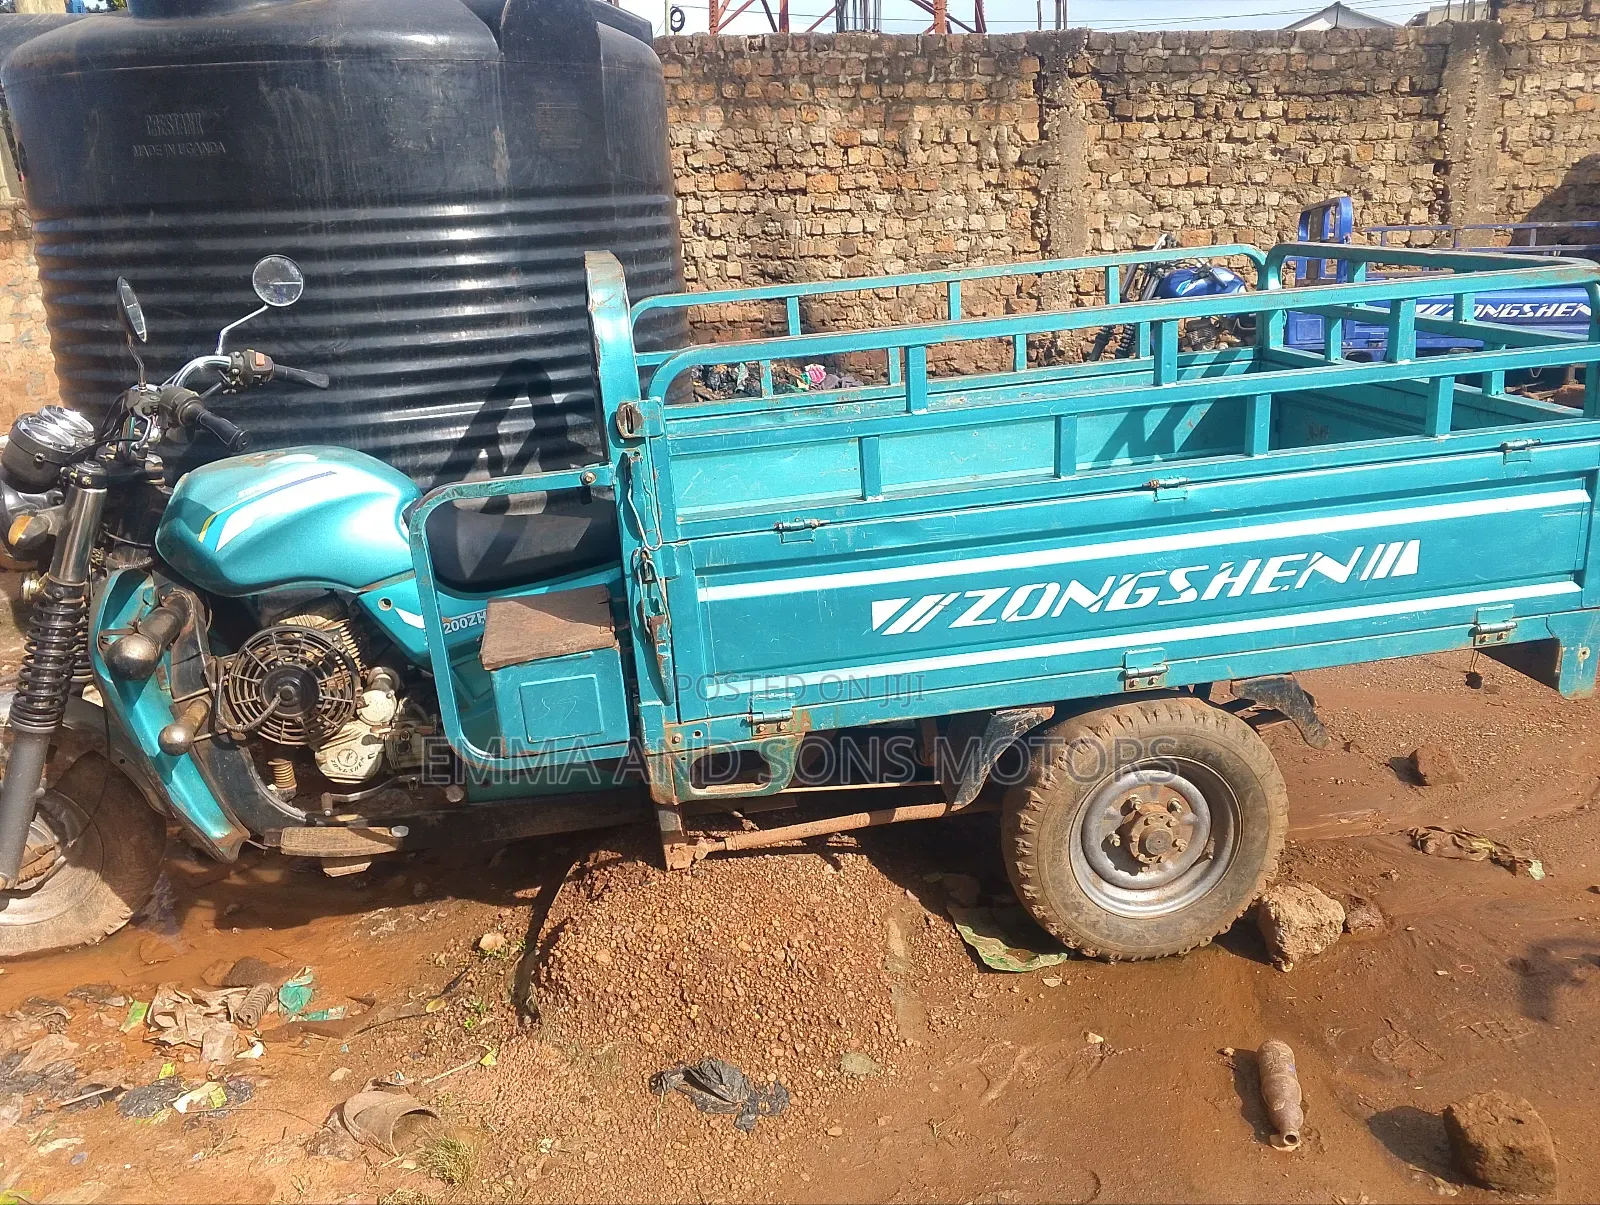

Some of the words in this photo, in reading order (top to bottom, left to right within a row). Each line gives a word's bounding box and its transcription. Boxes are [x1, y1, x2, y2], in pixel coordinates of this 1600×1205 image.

[132, 144, 162, 158] MADE
[163, 143, 176, 157] IN
[178, 141, 227, 157] UGANDA
[948, 546, 1364, 630] ZONGSHEN
